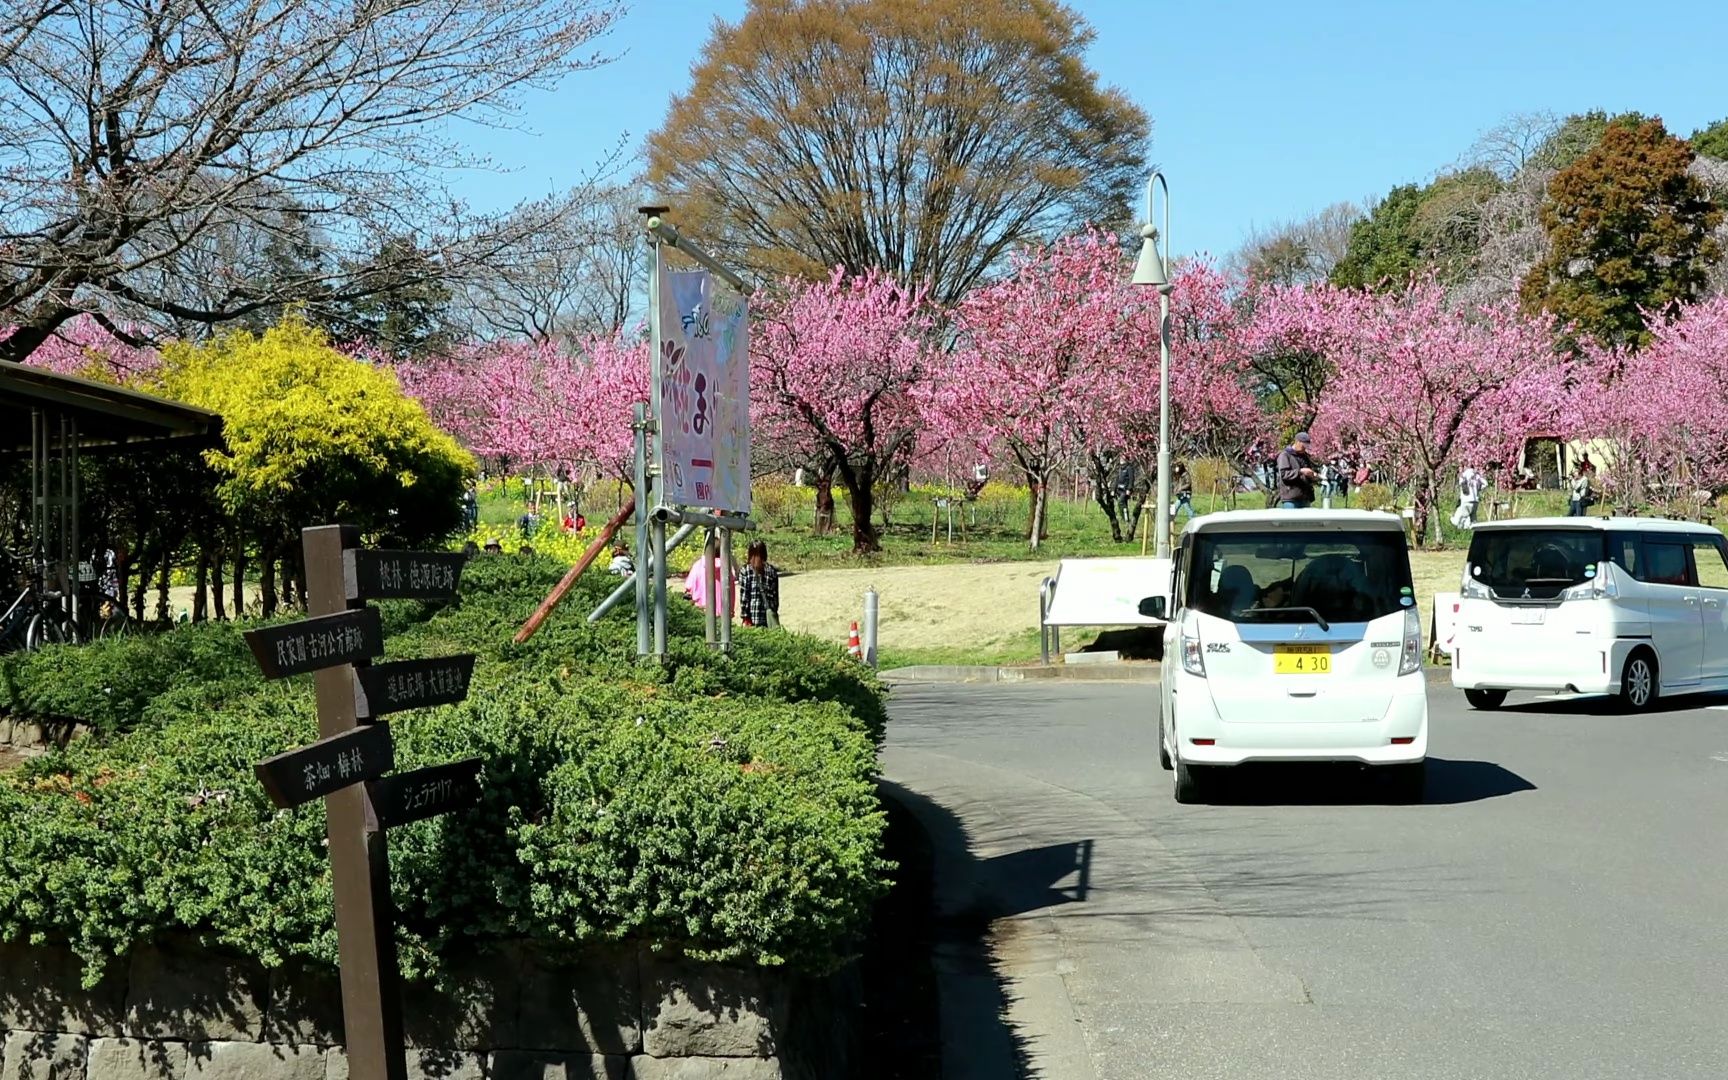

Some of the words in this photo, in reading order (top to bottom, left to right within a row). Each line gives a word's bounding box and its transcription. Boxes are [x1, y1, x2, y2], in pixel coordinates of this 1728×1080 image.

[303, 746, 365, 792] 茶畑・梅林
[404, 778, 453, 811] ジェラテリア
